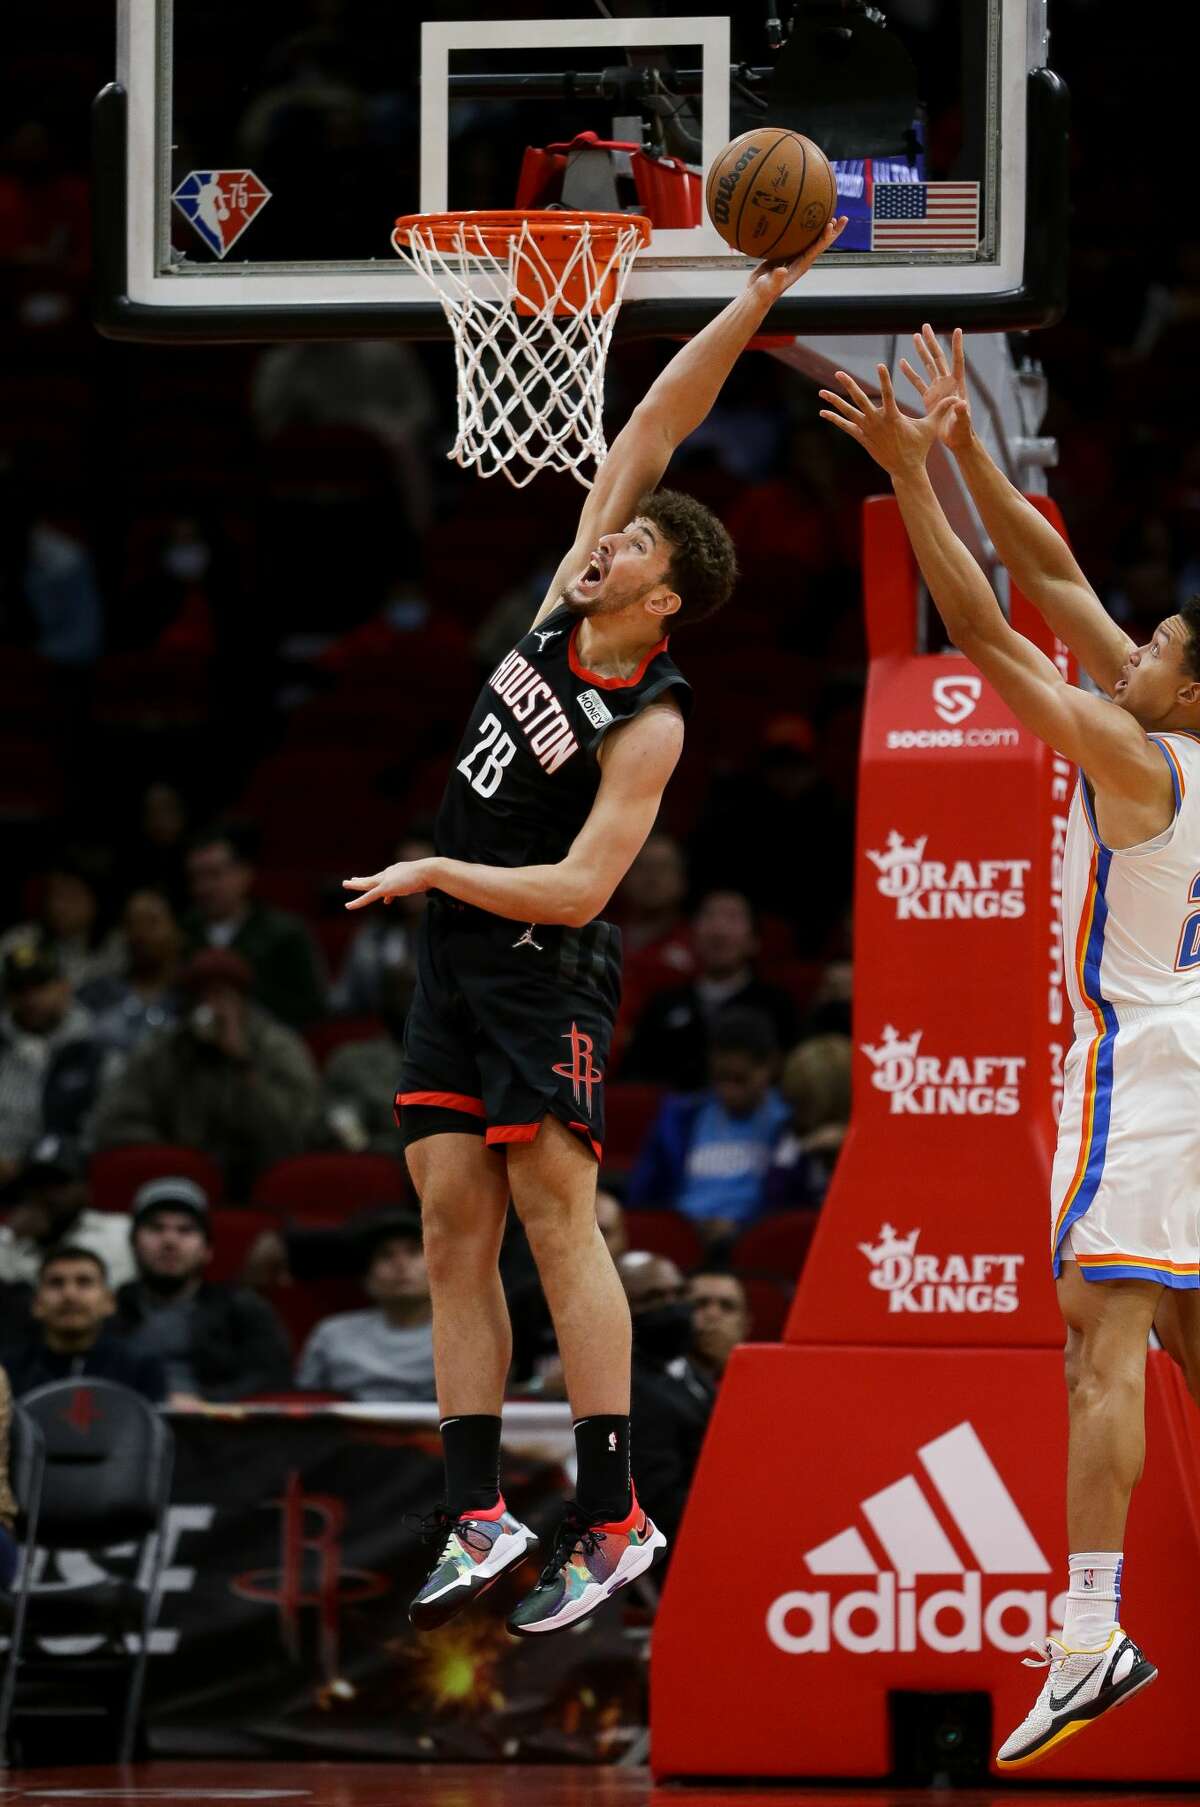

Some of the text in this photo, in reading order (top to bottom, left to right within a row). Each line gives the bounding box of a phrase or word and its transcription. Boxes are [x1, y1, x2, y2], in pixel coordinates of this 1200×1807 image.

[229, 182, 248, 209] 75
[488, 649, 579, 775] HOUSTON
[579, 693, 605, 726] MONEY
[456, 712, 518, 799] 28
[877, 861, 1031, 898] DRAFT
[896, 890, 1026, 920] KINGS
[871, 1056, 1026, 1092] DRAFT
[889, 1086, 1021, 1116] KINGS
[868, 1254, 1025, 1291] DRAFT
[888, 1284, 1019, 1314] KINGS
